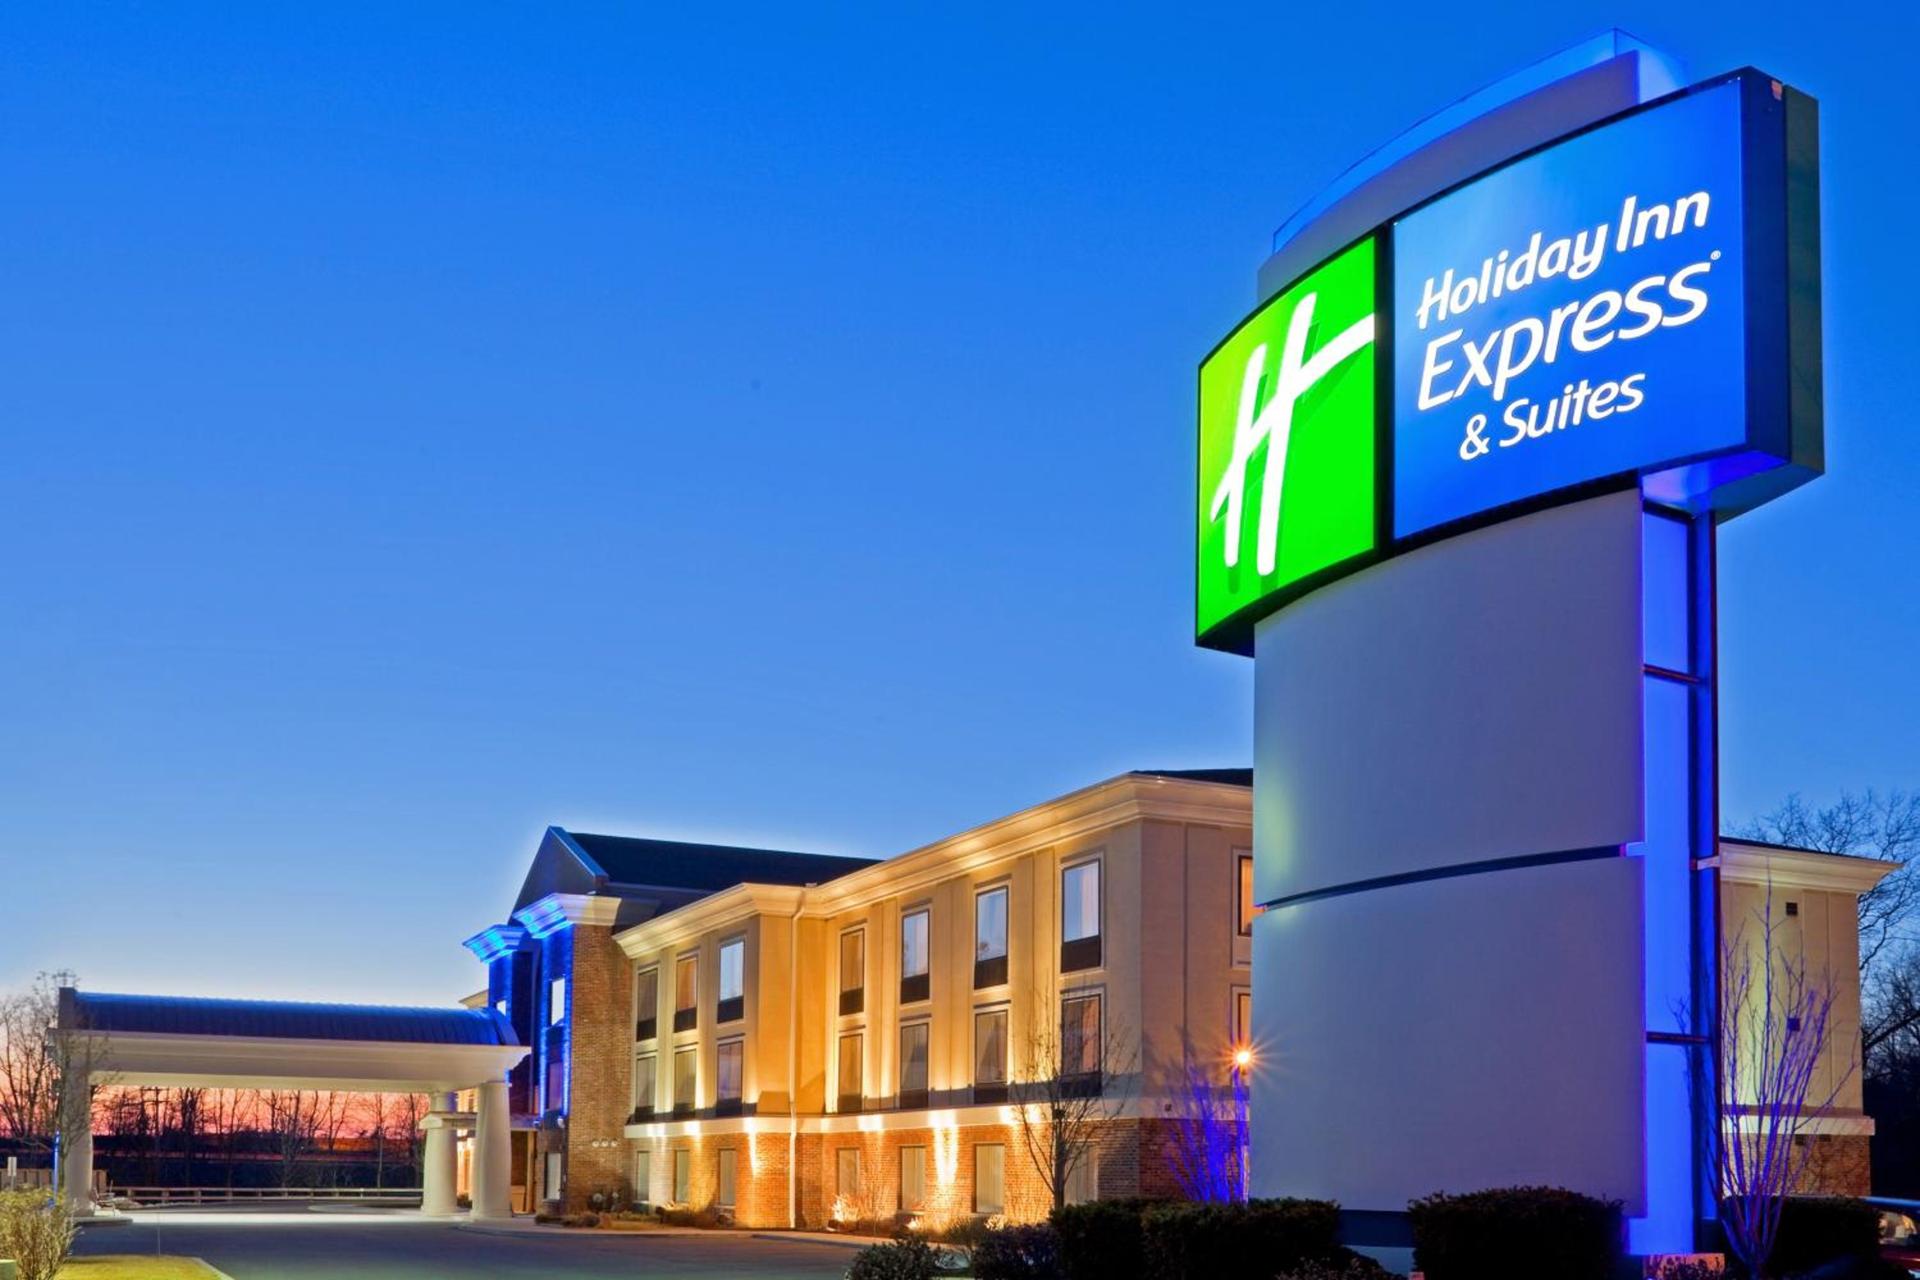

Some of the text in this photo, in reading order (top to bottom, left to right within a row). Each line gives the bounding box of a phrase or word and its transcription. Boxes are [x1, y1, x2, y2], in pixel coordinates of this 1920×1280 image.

[1415, 191, 1710, 330] Holiday Inn
[1417, 262, 1711, 411] Express
[1459, 373, 1646, 460] & Suites
